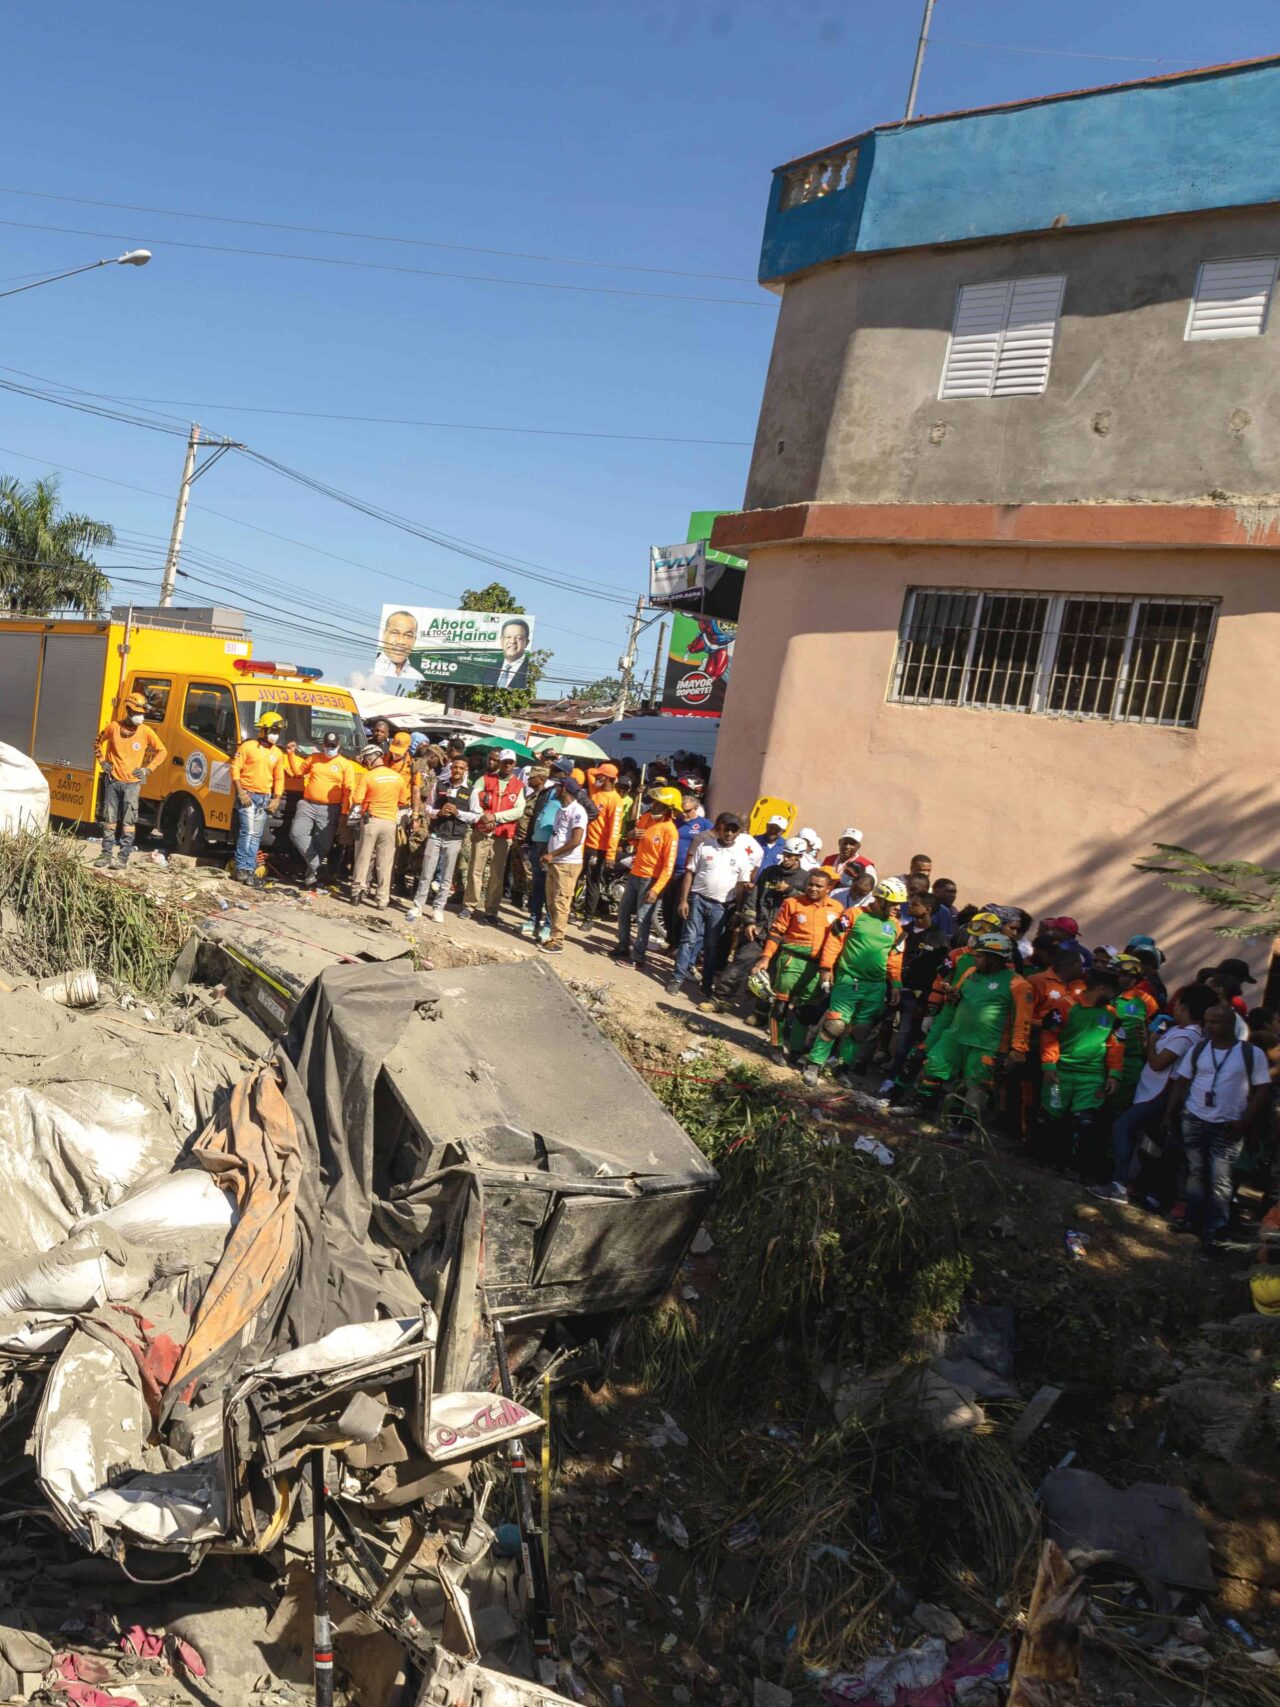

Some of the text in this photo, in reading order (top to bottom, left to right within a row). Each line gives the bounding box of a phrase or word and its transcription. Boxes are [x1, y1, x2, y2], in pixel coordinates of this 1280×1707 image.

[429, 618, 475, 630] Ahora
[452, 629, 497, 642] Haina
[421, 659, 458, 671] Brito
[57, 779, 81, 791] SANTO
[51, 790, 85, 806] DOMINGO
[210, 809, 228, 823] F-01
